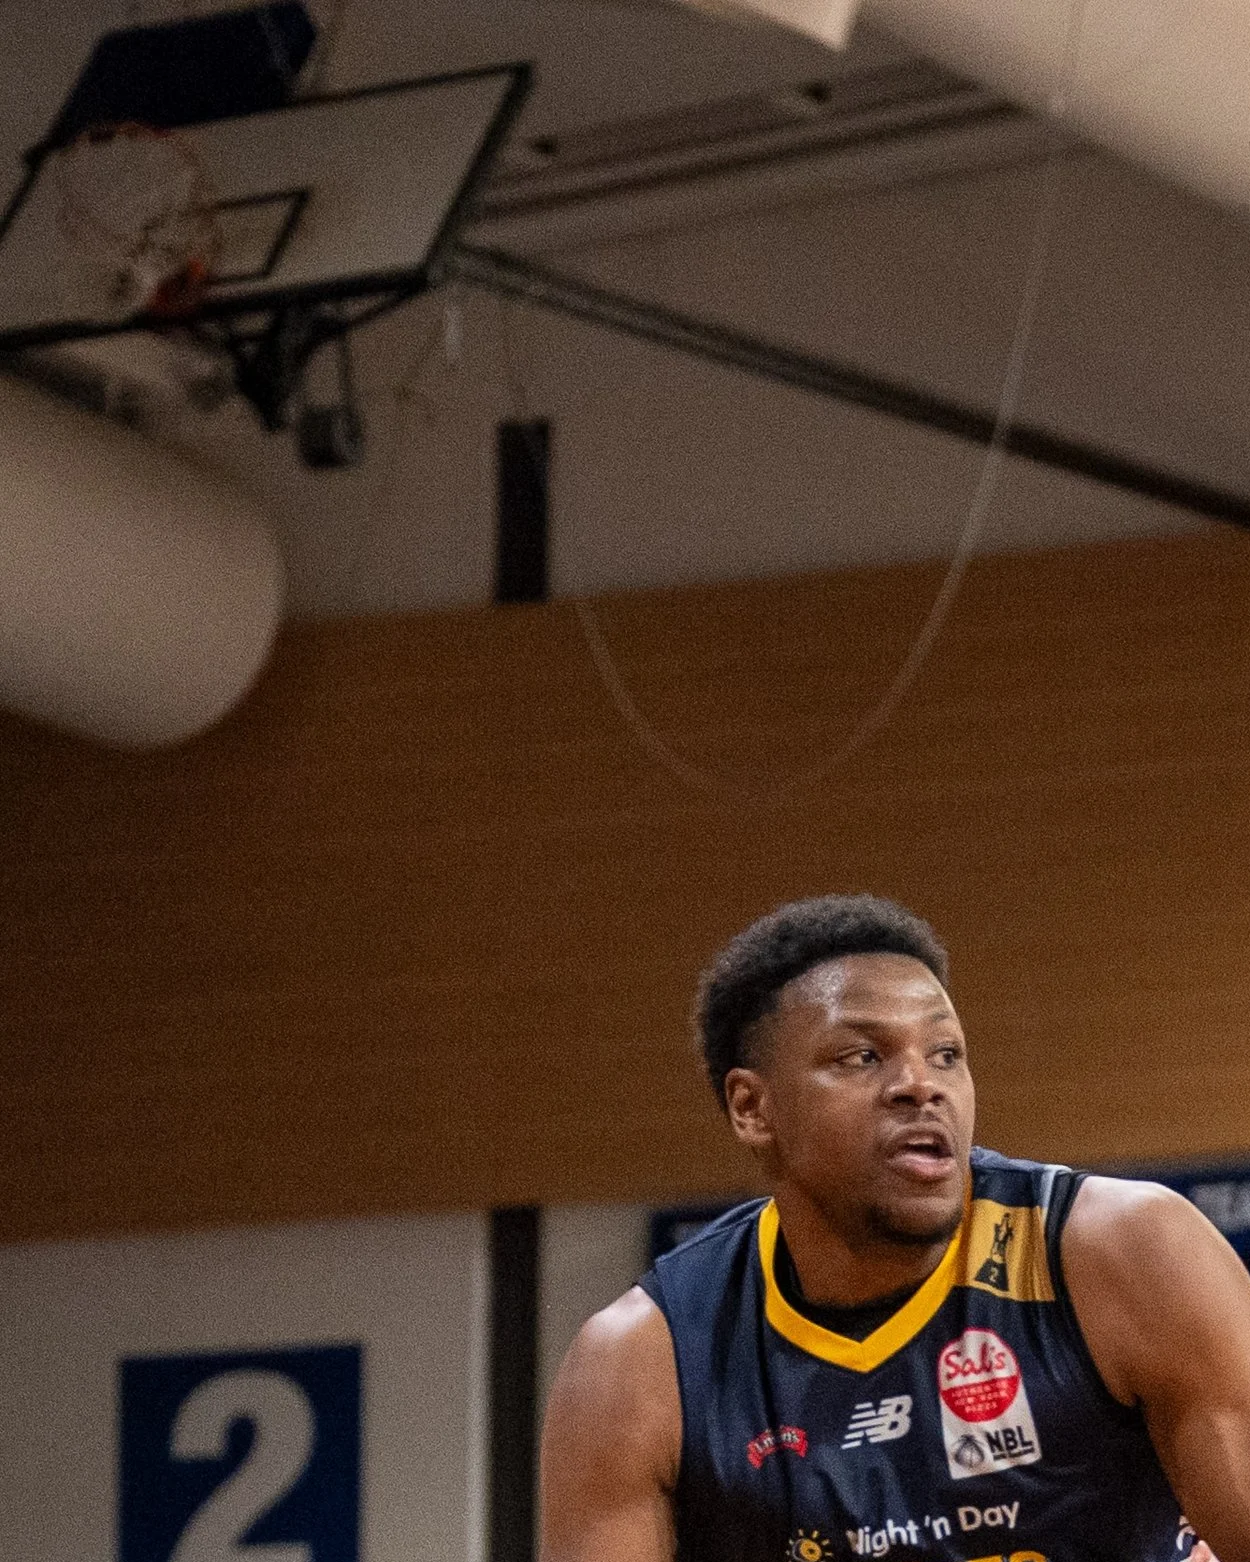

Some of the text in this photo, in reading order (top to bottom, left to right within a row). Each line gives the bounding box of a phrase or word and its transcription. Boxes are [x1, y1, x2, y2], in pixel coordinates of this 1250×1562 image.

[944, 1341, 1007, 1381] Sal's
[985, 1425, 1034, 1453] NBL
[957, 1501, 1020, 1532] Day
